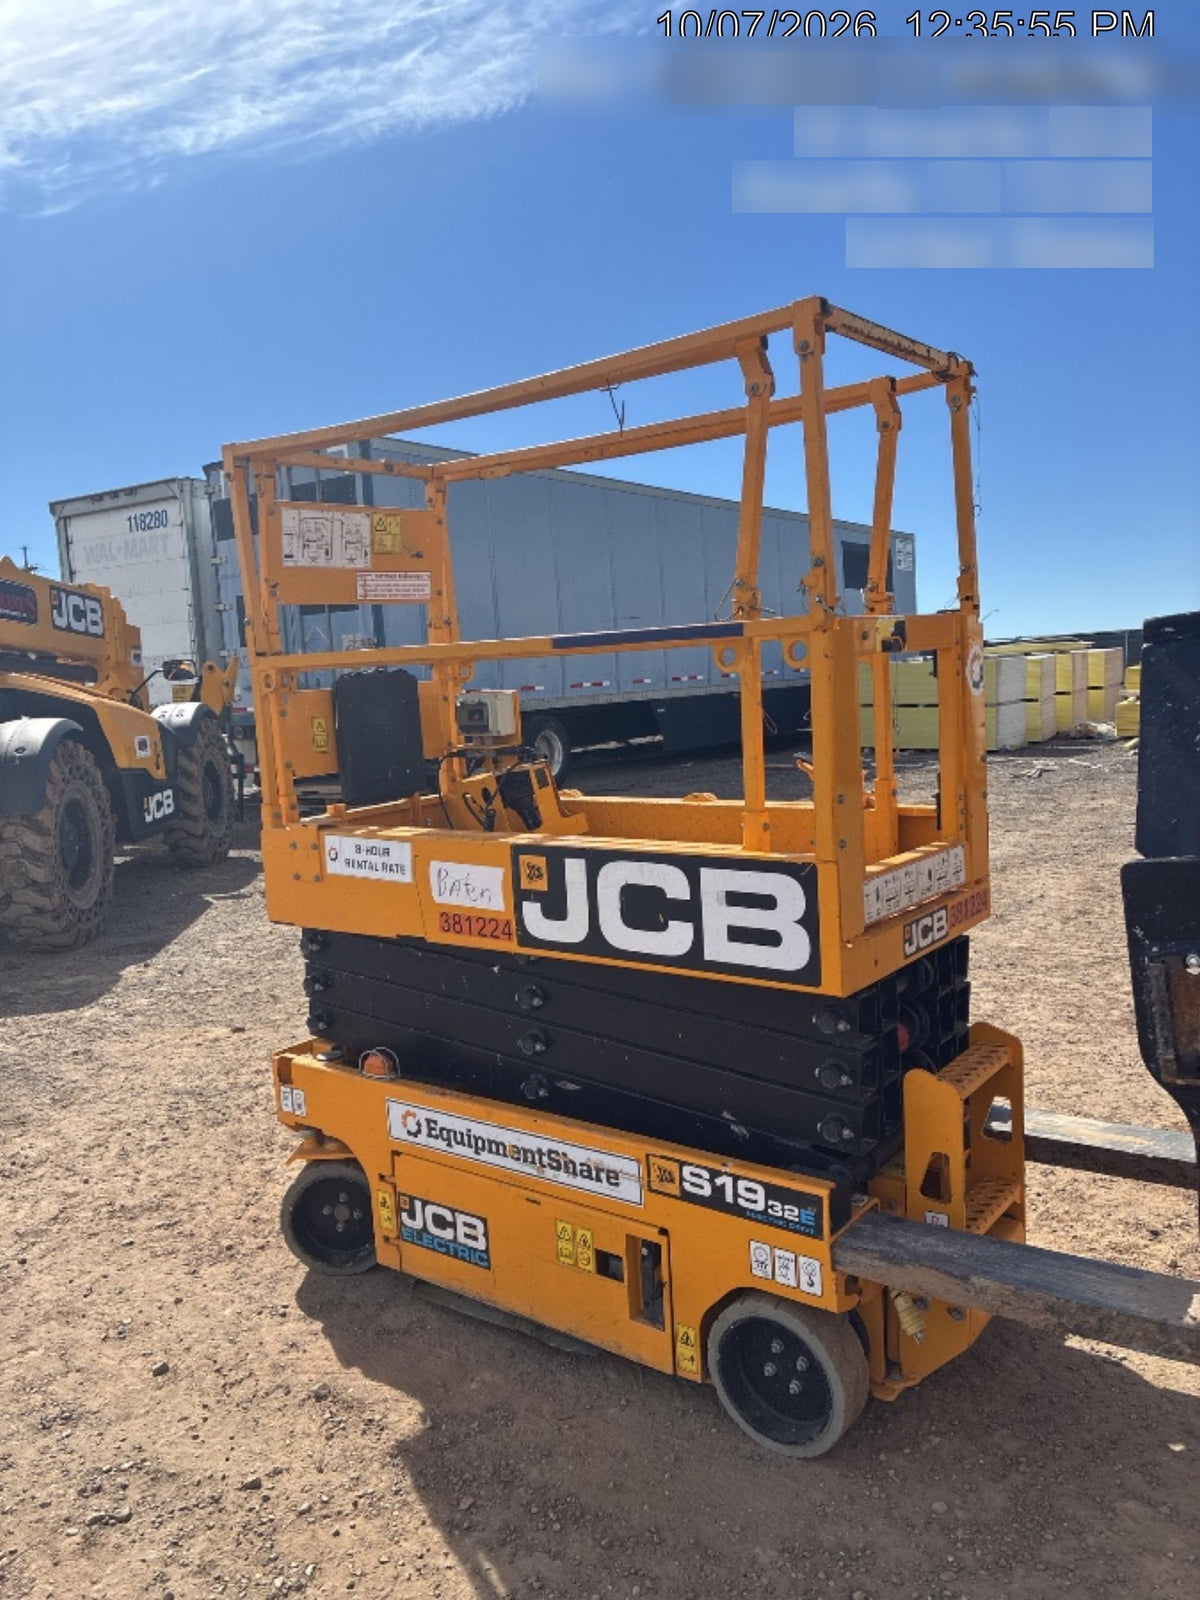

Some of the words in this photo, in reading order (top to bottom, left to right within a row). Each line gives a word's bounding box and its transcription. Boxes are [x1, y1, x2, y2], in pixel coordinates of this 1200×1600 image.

[127, 510, 168, 532] 118280
[53, 591, 104, 635] JCB
[145, 789, 174, 823] JCB
[344, 858, 379, 872] RENTAL
[381, 863, 406, 875] RATE
[440, 911, 513, 941] 381224
[522, 858, 811, 971] JCB
[904, 909, 947, 955] JCB
[424, 1117, 620, 1187] EquipmentShare
[401, 1199, 487, 1251] JCB
[402, 1227, 489, 1267] ELECTRIC
